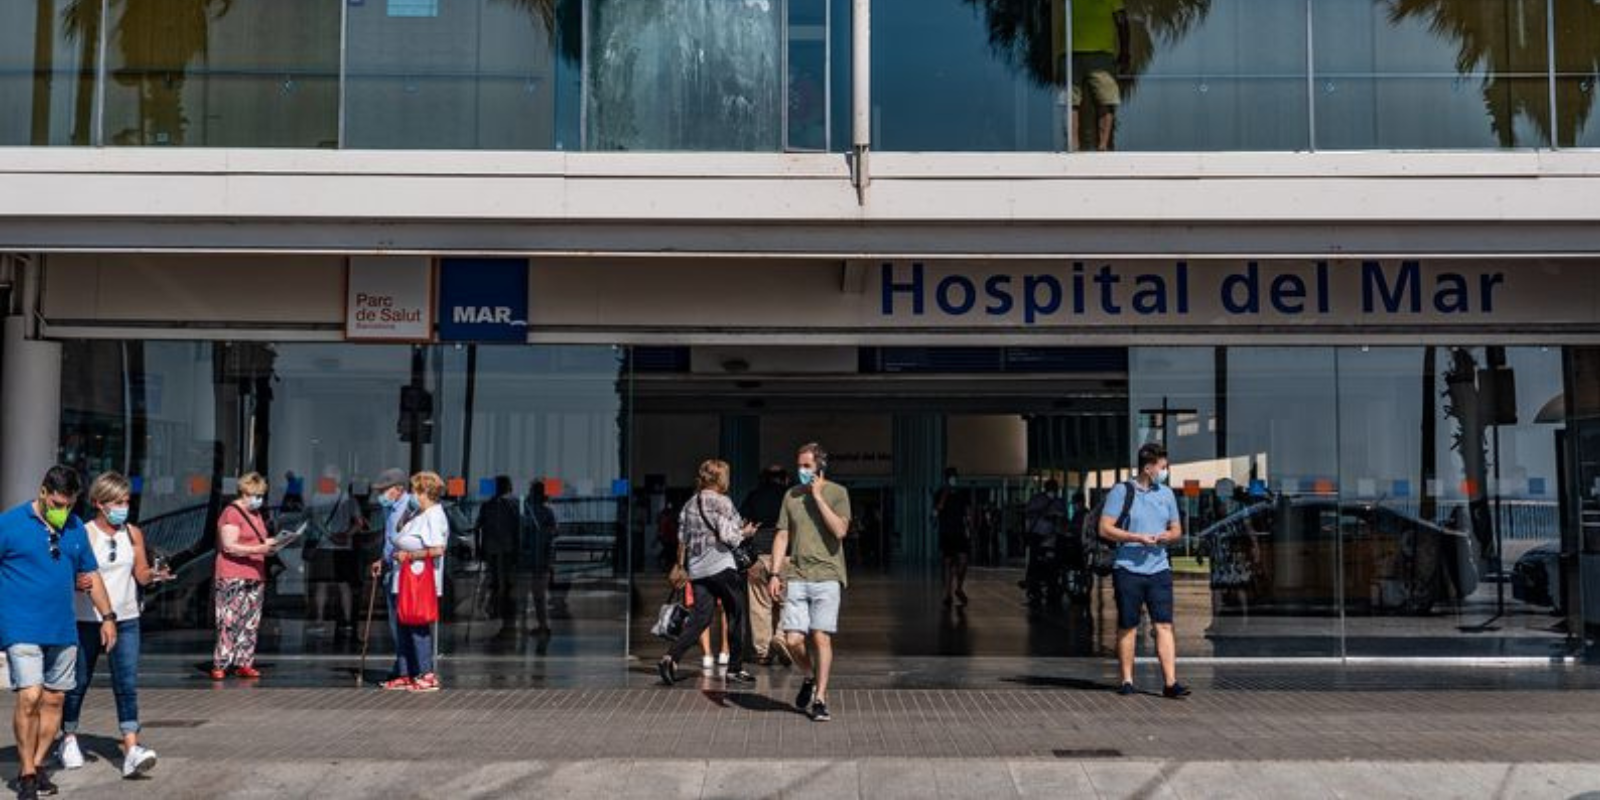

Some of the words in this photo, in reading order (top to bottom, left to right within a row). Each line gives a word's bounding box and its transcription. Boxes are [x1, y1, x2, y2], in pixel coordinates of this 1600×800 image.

[881, 261, 1188, 323] Hospital
[1221, 261, 1330, 313] del
[1362, 260, 1504, 313] Mar
[356, 294, 393, 307] Parc
[356, 308, 375, 322] de
[381, 308, 420, 322] Salut
[454, 307, 511, 323] MAR
